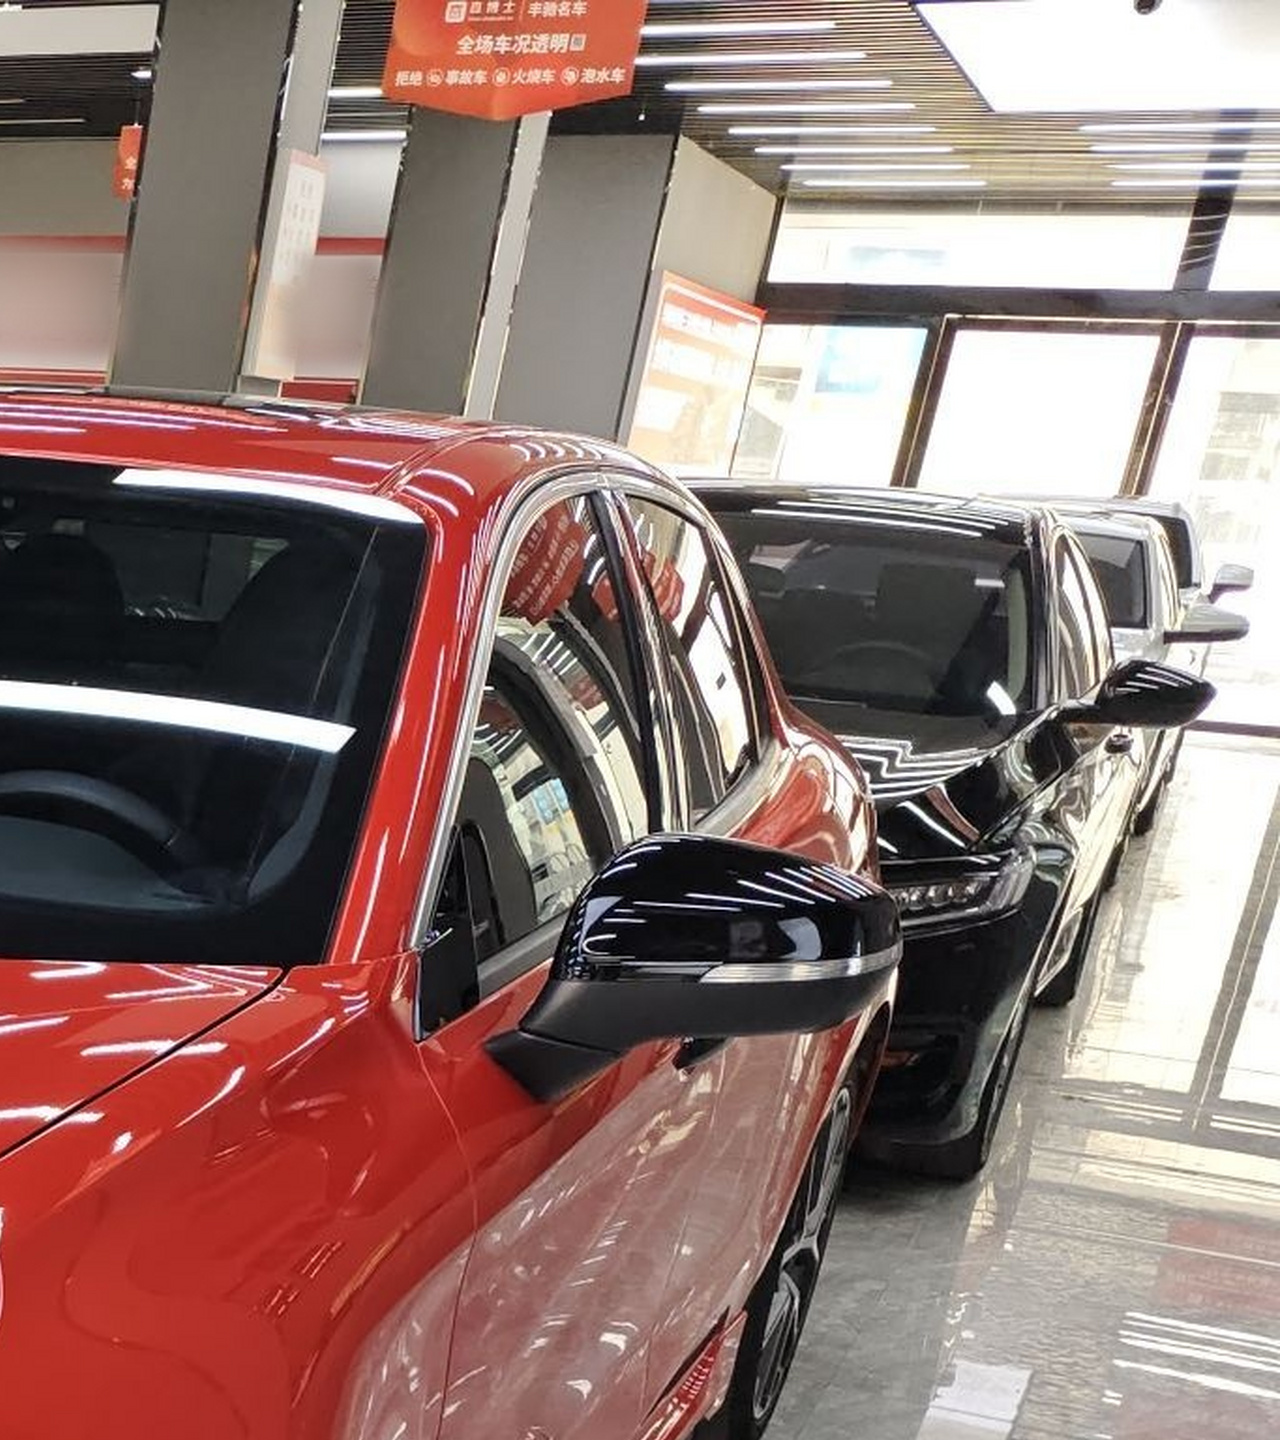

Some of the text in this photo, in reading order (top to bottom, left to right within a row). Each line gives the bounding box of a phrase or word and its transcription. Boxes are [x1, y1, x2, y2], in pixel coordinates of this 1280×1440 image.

[455, 33, 570, 55] 全场车况透明
[394, 67, 627, 87] 拒绝 事故车 火烧车 泡水车
